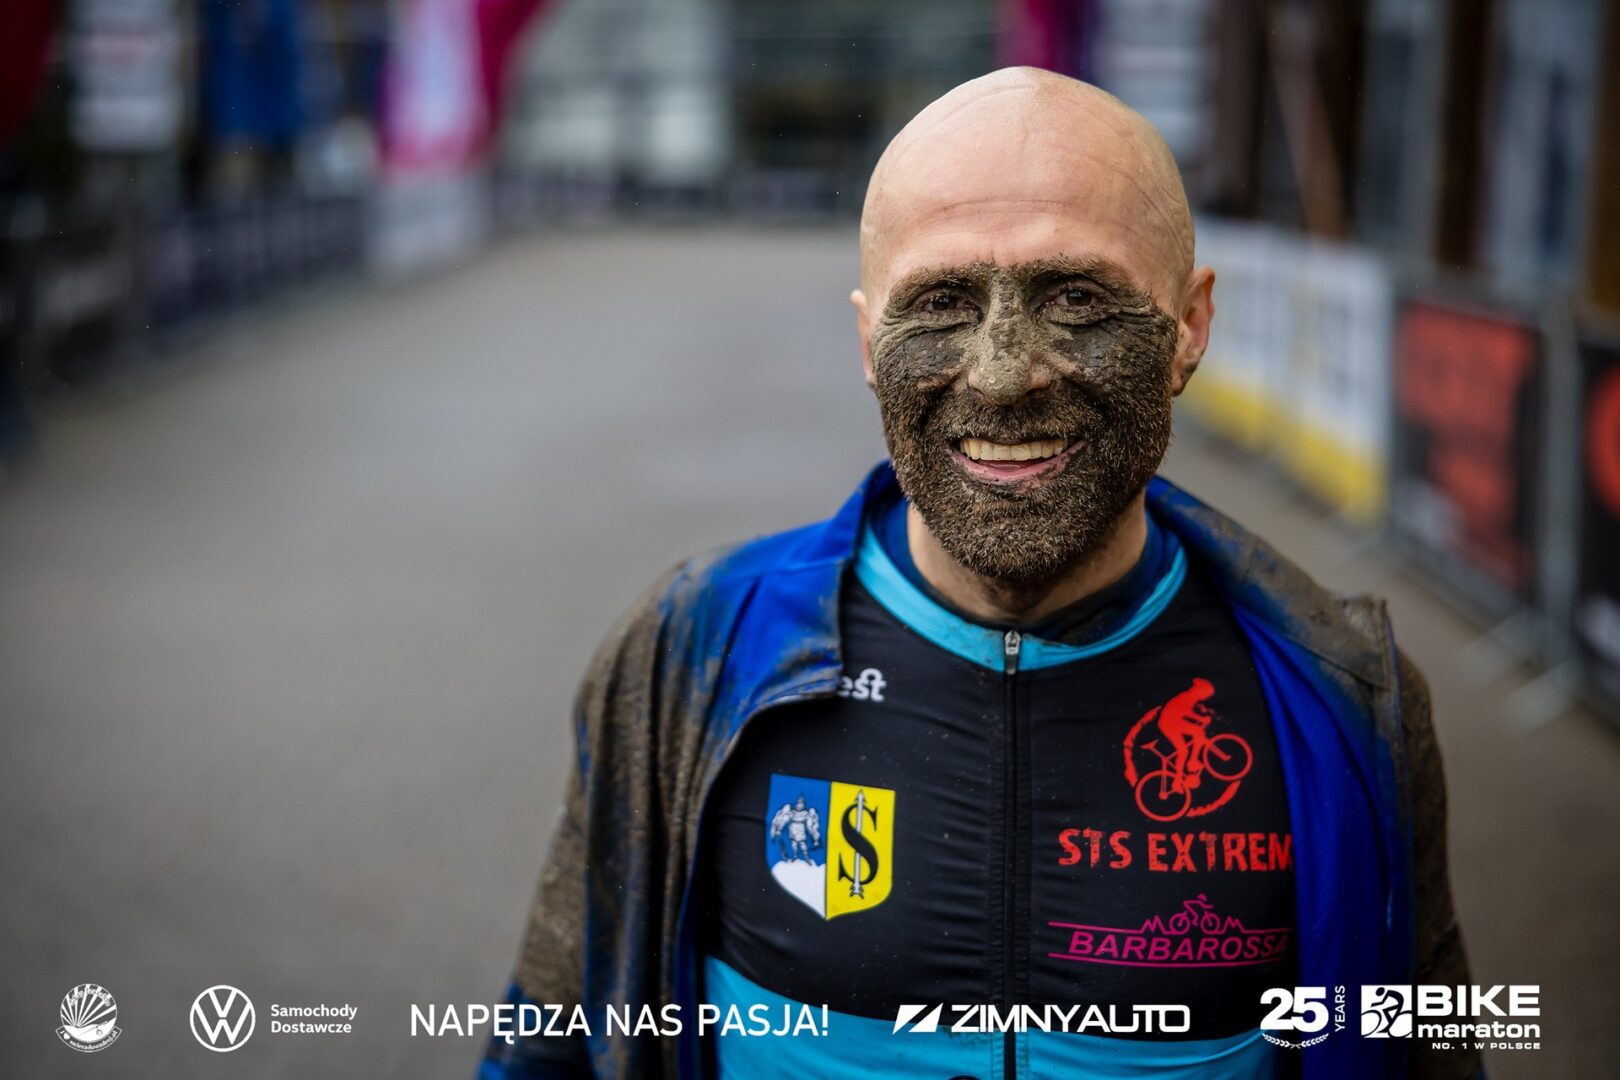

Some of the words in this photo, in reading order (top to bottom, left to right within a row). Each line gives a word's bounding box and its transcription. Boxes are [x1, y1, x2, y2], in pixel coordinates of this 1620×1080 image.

[1058, 828, 1132, 869] STS
[1147, 831, 1293, 872] EXTREM
[1068, 931, 1288, 961] BARBAROSSA
